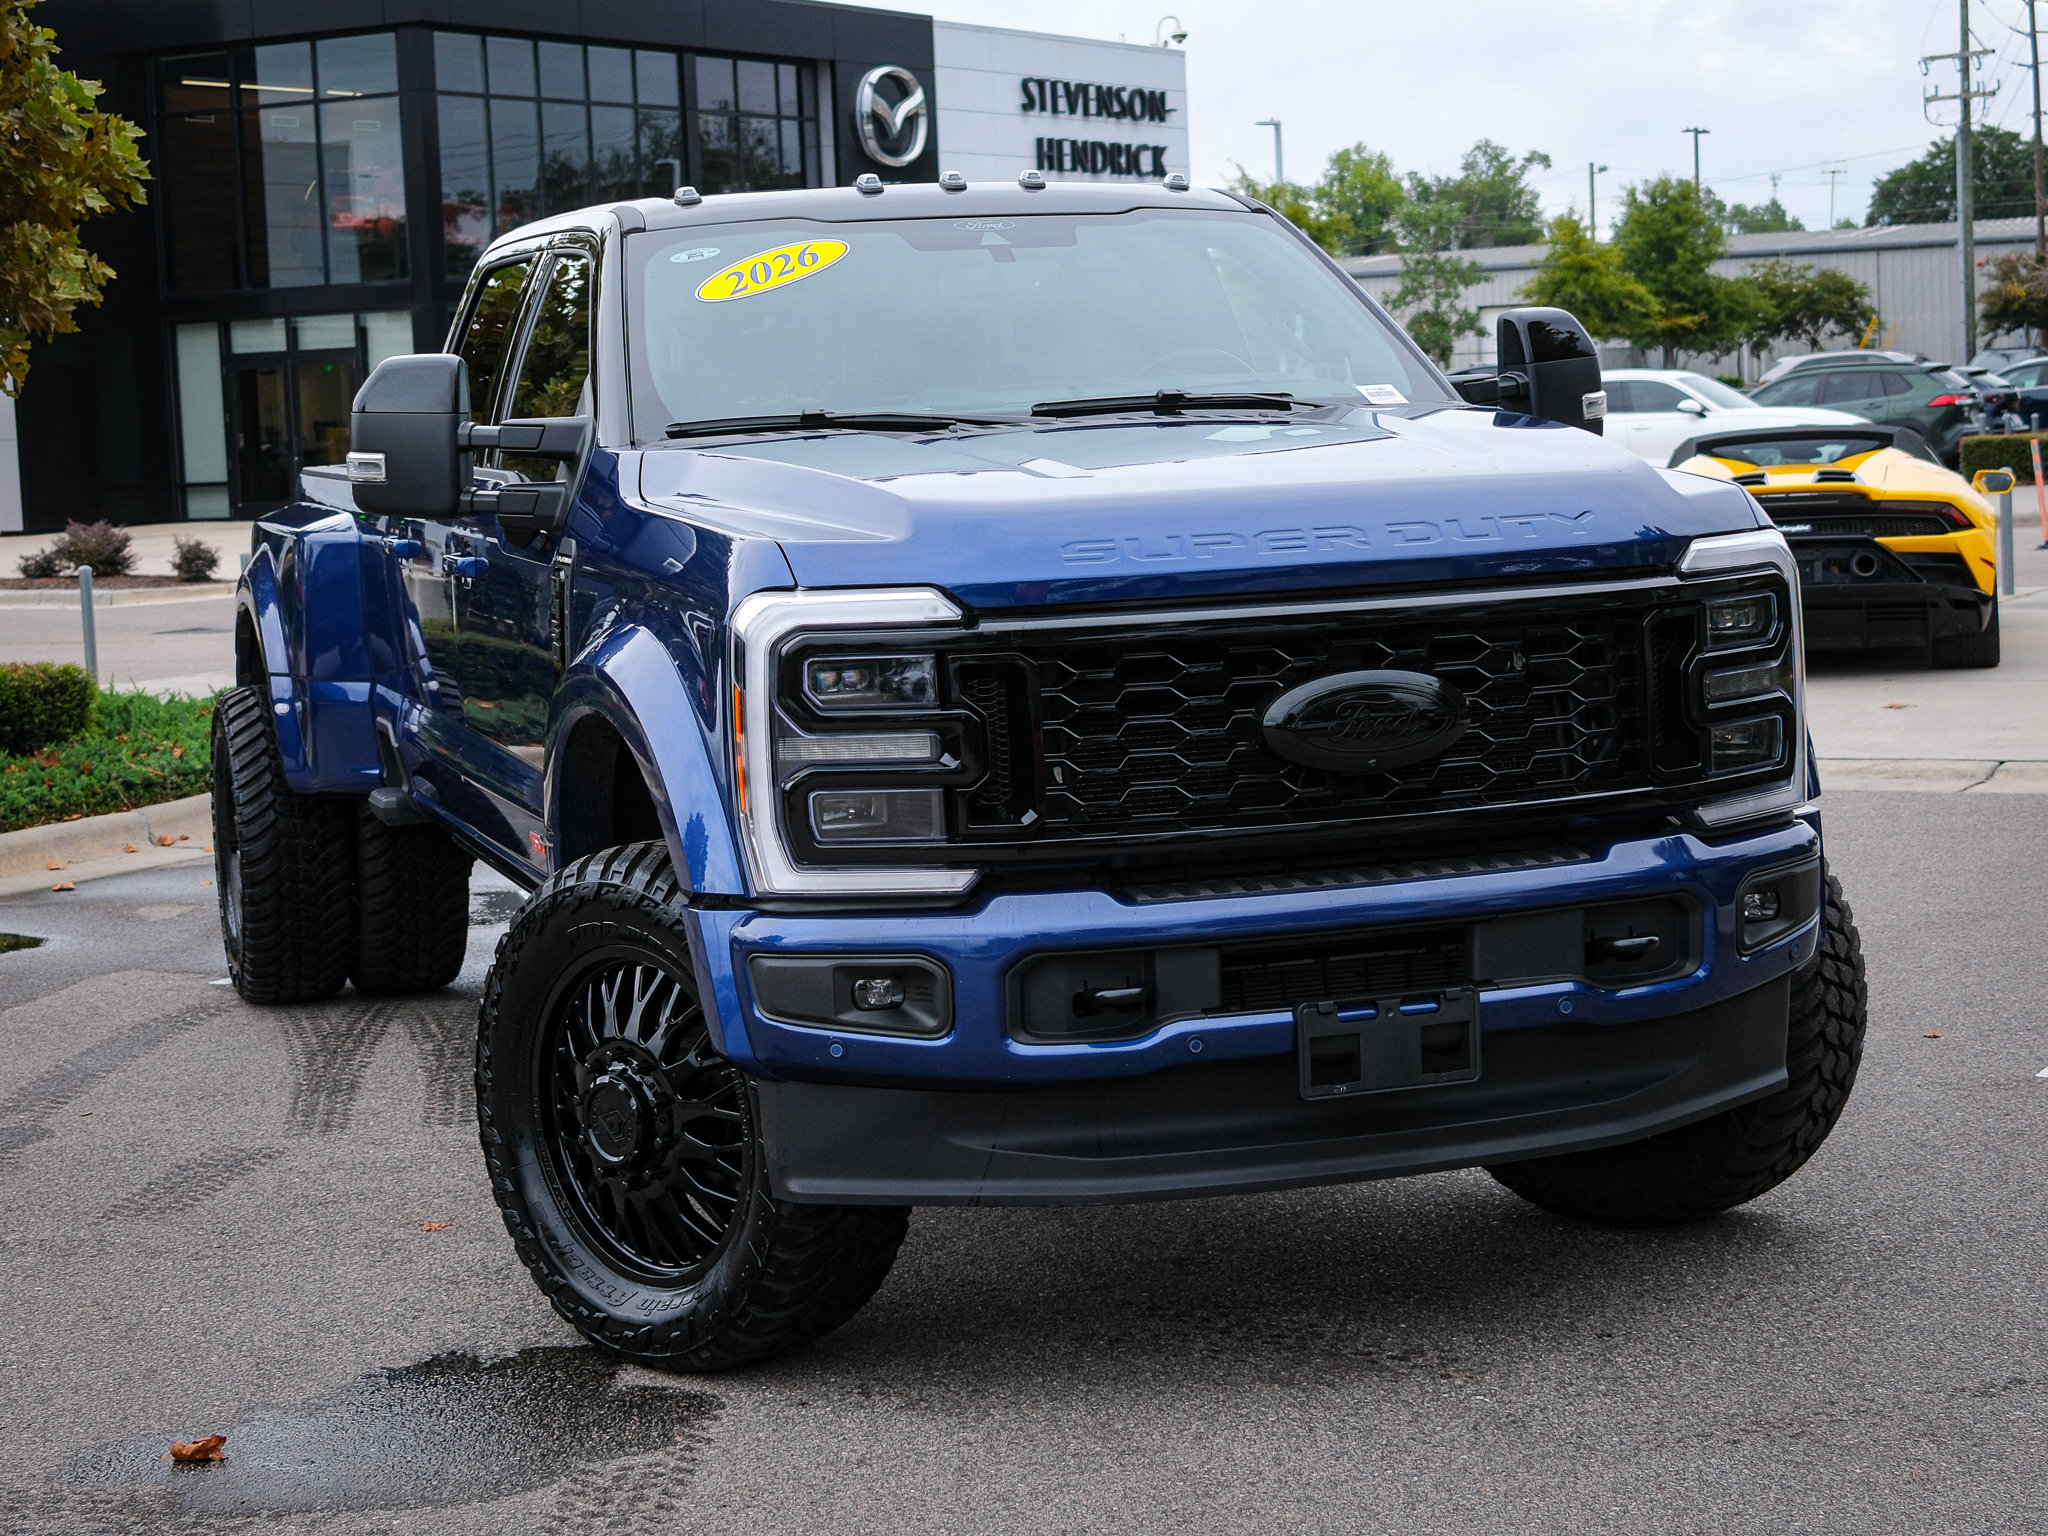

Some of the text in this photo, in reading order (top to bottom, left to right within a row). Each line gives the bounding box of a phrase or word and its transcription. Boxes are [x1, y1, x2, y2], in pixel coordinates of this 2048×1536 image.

[1021, 77, 1177, 123] STEVENSON-
[1036, 136, 1169, 178] HENDRICK
[966, 220, 1006, 230] Ford
[725, 243, 819, 296] 2026
[1060, 510, 1595, 566] SUPER DUTY
[1327, 699, 1421, 740] Ford
